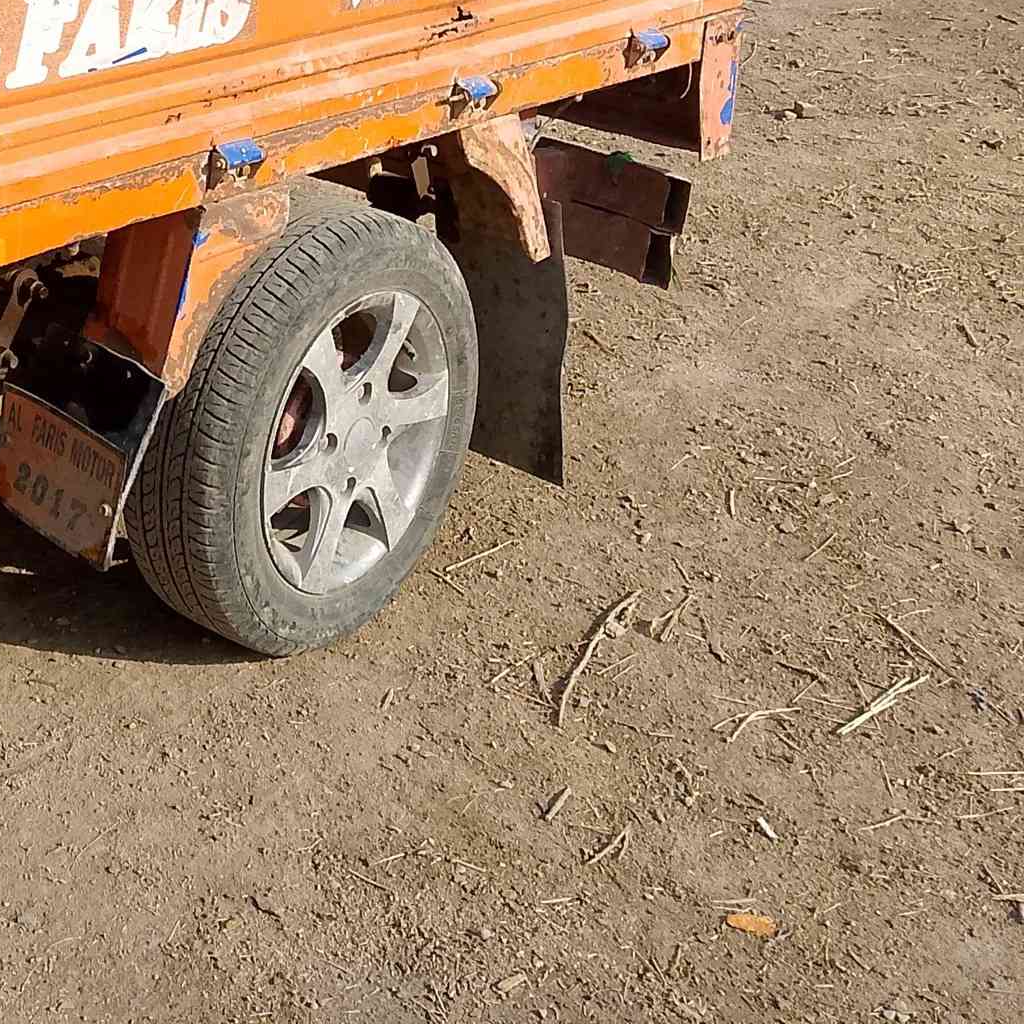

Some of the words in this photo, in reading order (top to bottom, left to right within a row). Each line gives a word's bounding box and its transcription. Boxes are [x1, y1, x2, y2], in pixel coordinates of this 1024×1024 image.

[7, 401, 22, 432] AL
[32, 415, 67, 456] FARIS
[72, 438, 114, 488] MOTOR
